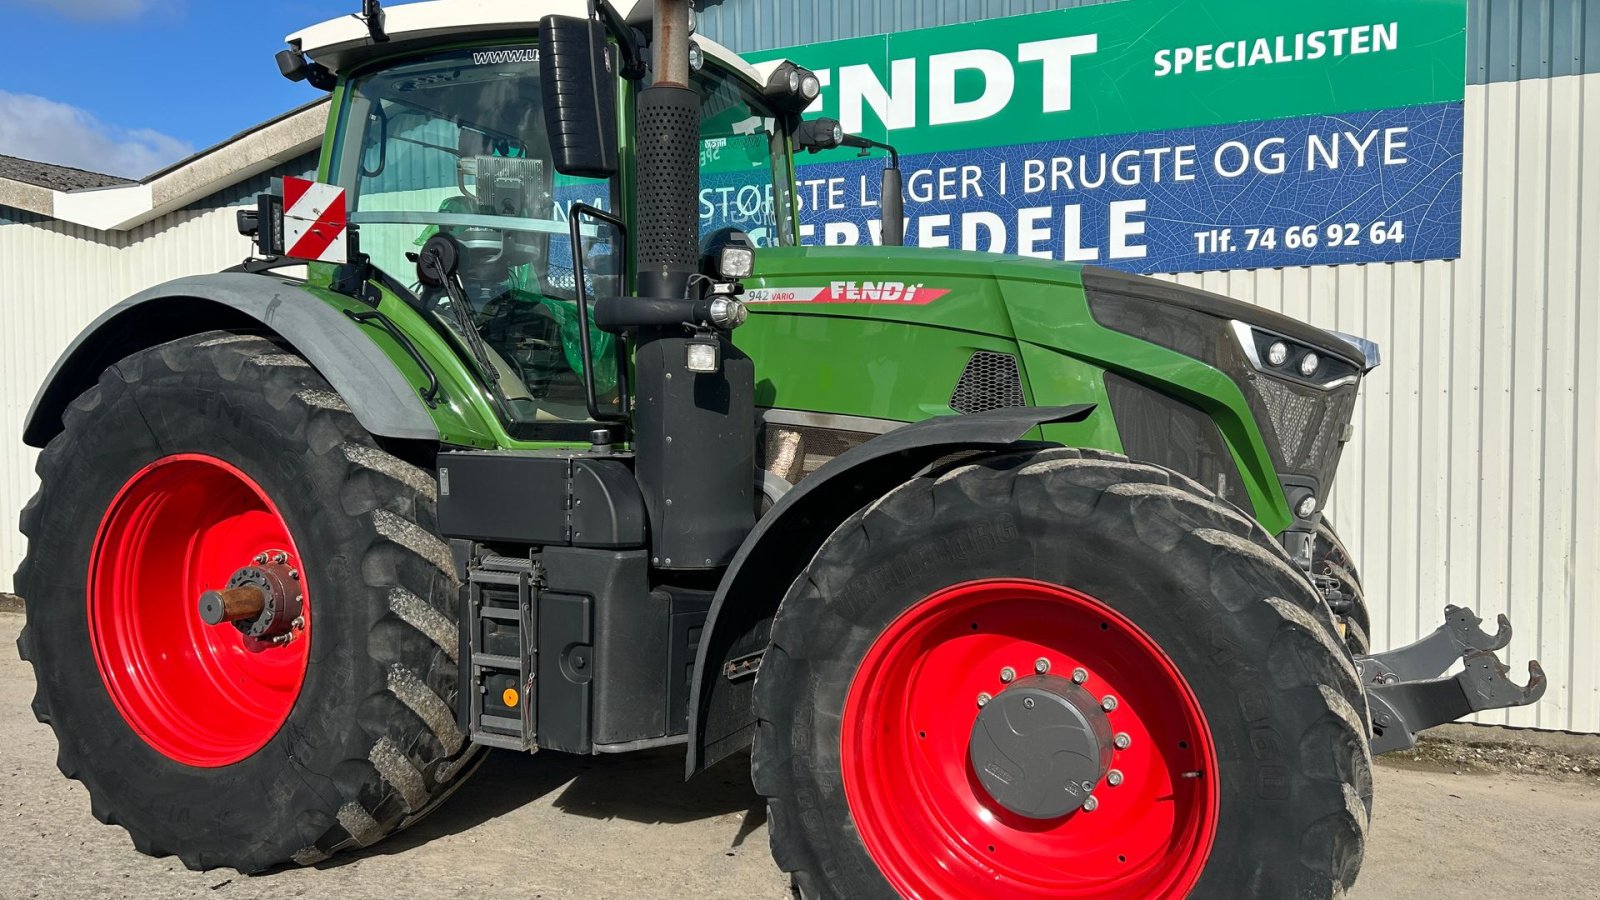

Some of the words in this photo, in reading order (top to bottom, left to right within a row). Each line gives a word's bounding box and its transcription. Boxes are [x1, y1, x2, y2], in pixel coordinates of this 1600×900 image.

[473, 48, 540, 65] www.u
[750, 33, 1098, 136] NDT
[1154, 22, 1398, 77] SPECIALISTEN
[860, 165, 984, 207] LGER
[999, 162, 1006, 196] I
[1024, 144, 1196, 193] BRUGTE
[1214, 137, 1286, 178] OG
[1307, 126, 1409, 171] NYE
[1194, 228, 1237, 253] Tlf.
[1245, 227, 1277, 251] 74
[1285, 225, 1319, 249] 66
[1326, 222, 1360, 247] 92
[1369, 220, 1405, 244] 64
[748, 290, 769, 301] 942
[771, 292, 795, 300] VARIO
